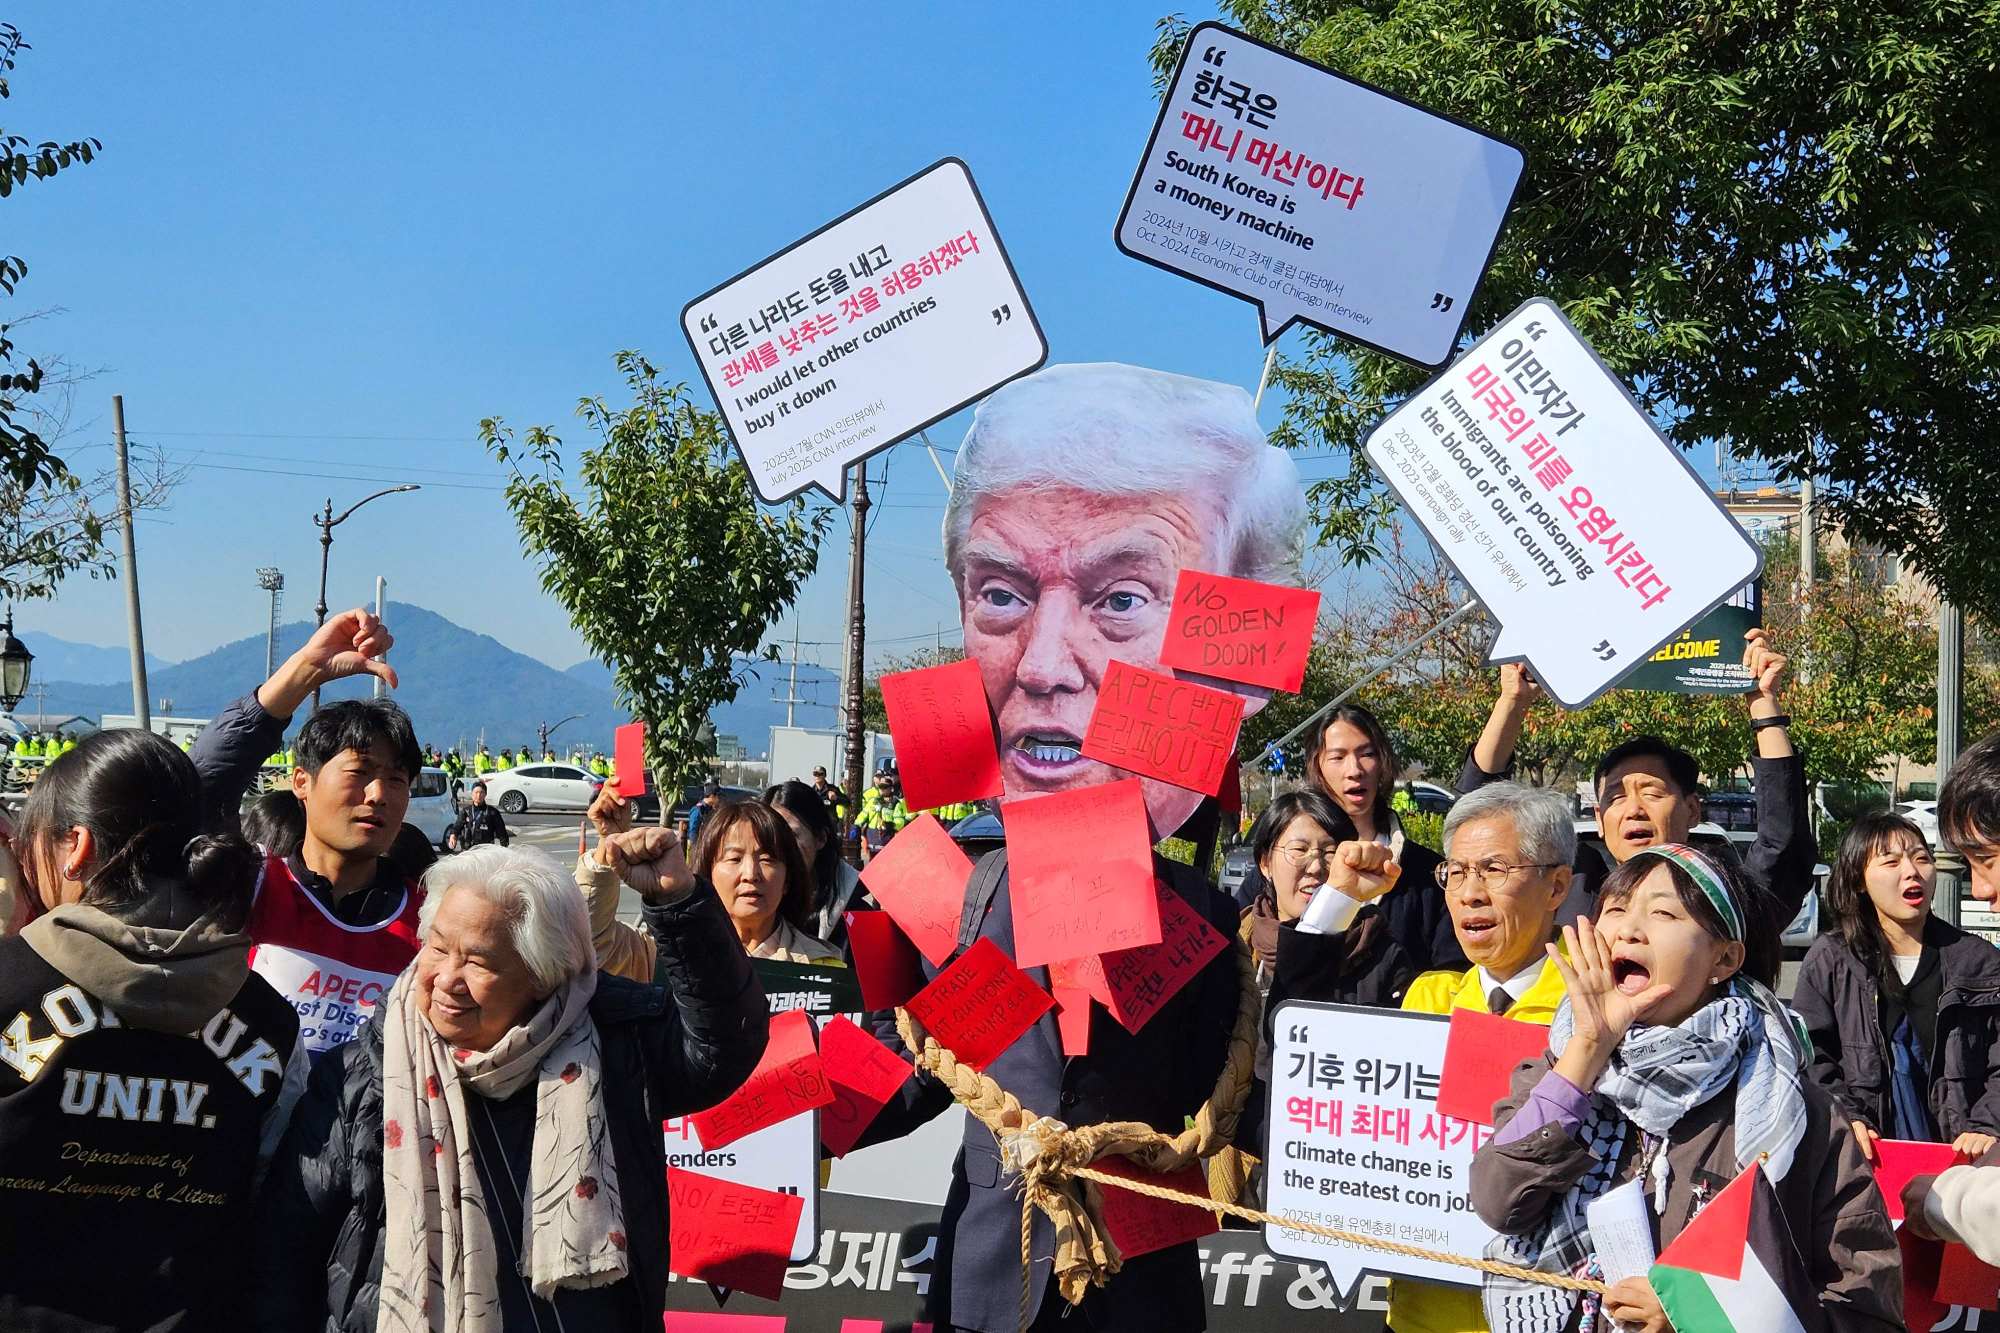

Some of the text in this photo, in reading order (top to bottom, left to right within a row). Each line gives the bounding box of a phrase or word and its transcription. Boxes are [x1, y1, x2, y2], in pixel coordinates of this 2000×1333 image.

[1190, 69, 1279, 130] 한국은
[1163, 150, 1297, 215] South Korea is
[1244, 137, 1365, 211] 머신'이다
[1154, 178, 1315, 251] a money machine
[1142, 209, 1345, 299] 2024년 10월 시카고 경제 클럽 대담에서
[1159, 235, 1190, 256] 2024
[1190, 246, 1242, 277] Economic
[1243, 267, 1267, 286] Club
[1268, 278, 1281, 291] of
[1281, 281, 1323, 308] Chicago
[1323, 298, 1374, 326] interview
[708, 244, 893, 356] 다른 나라도 돈을 내고
[720, 230, 981, 388] 관세를 낮추는 것을 허용하겠다
[734, 294, 938, 412] I would let other countries
[743, 378, 838, 434] buy it down
[1500, 337, 1586, 437] 이민자가
[762, 399, 886, 473] 2025년 7월 CNN 인터뷰에서
[770, 424, 878, 488] July 2025 CNN interview
[1394, 427, 1425, 461] 2023년
[1420, 457, 1443, 485] 12월
[1458, 508, 1481, 533] 경선
[1473, 528, 1497, 554] 선거
[1489, 549, 1529, 593] 유세에서
[1396, 457, 1420, 485] 2023
[1414, 483, 1451, 529] campaign
[1447, 524, 1467, 545] rally
[1419, 405, 1567, 588] the blood of our country
[1439, 388, 1596, 582] Immigrants are poisoning
[1465, 362, 1673, 611] 미국의 피를 오염시킨다
[1182, 606, 1285, 639] GOLDEN
[1648, 639, 1721, 662] ELCOME
[298, 968, 383, 1007] APEC
[931, 966, 978, 1007] TRADE
[59, 1067, 217, 1129] UNIV.
[1287, 1051, 1345, 1091] 기후
[1353, 1058, 1441, 1101] 위기는
[1286, 1096, 1494, 1155] 역대 최대 사기
[49, 1174, 141, 1204] Language
[146, 1182, 162, 1200] &
[60, 1141, 194, 1177] Department of
[1283, 1168, 1315, 1190] the
[1318, 1176, 1400, 1203] greatest
[1404, 1189, 1441, 1209] con
[1284, 1140, 1453, 1180] Climate change is
[717, 1193, 778, 1225] 트럼프
[1280, 1207, 1450, 1247] 2025년 9월 유엔총회 연설에서
